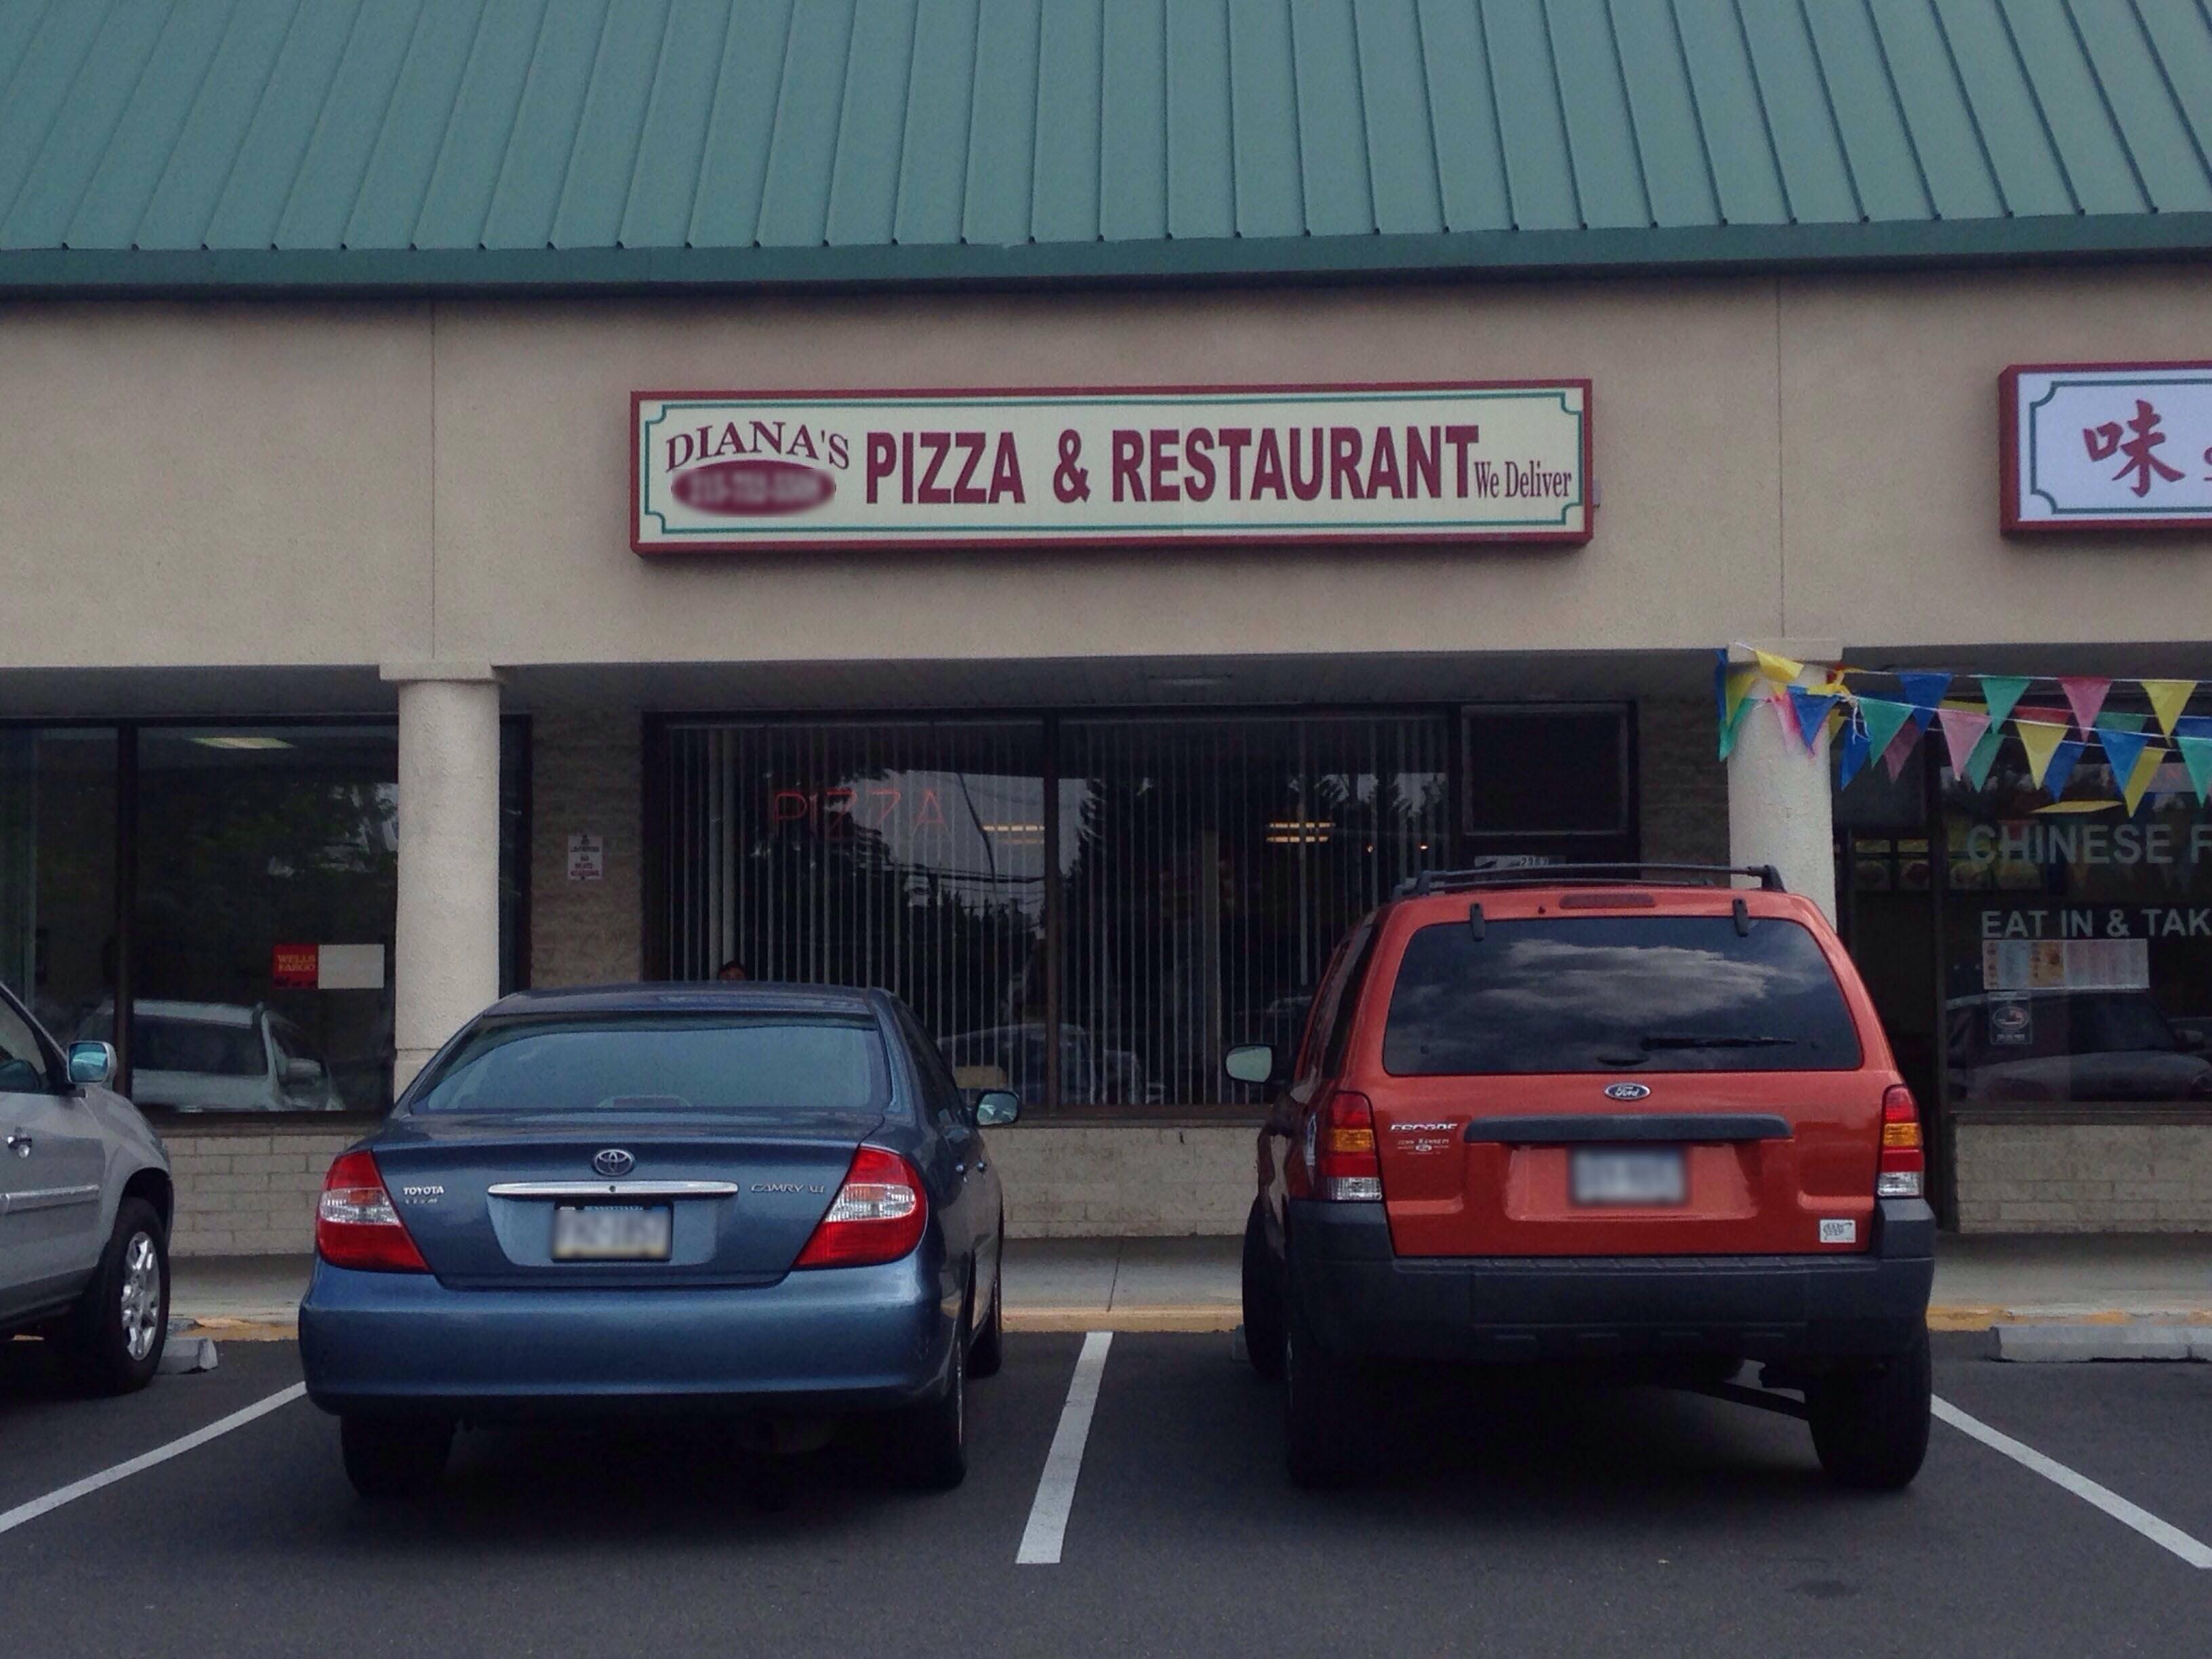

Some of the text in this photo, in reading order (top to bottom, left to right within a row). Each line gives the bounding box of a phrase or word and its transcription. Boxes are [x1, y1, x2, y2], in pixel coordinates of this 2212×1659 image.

[665, 421, 849, 473] DIANA'S
[2083, 399, 2186, 497] 味
[866, 425, 1479, 504] PIZZA & RESTAURANT
[1474, 460, 1572, 498] We Deliver
[1967, 823, 2173, 864] CHINESE
[1982, 908, 2212, 938] EAT IN & TAK
[277, 954, 316, 963] WELLS
[277, 963, 316, 972] FARGO
[403, 1186, 444, 1195] TOYOTA
[751, 1184, 804, 1192] CAMRY
